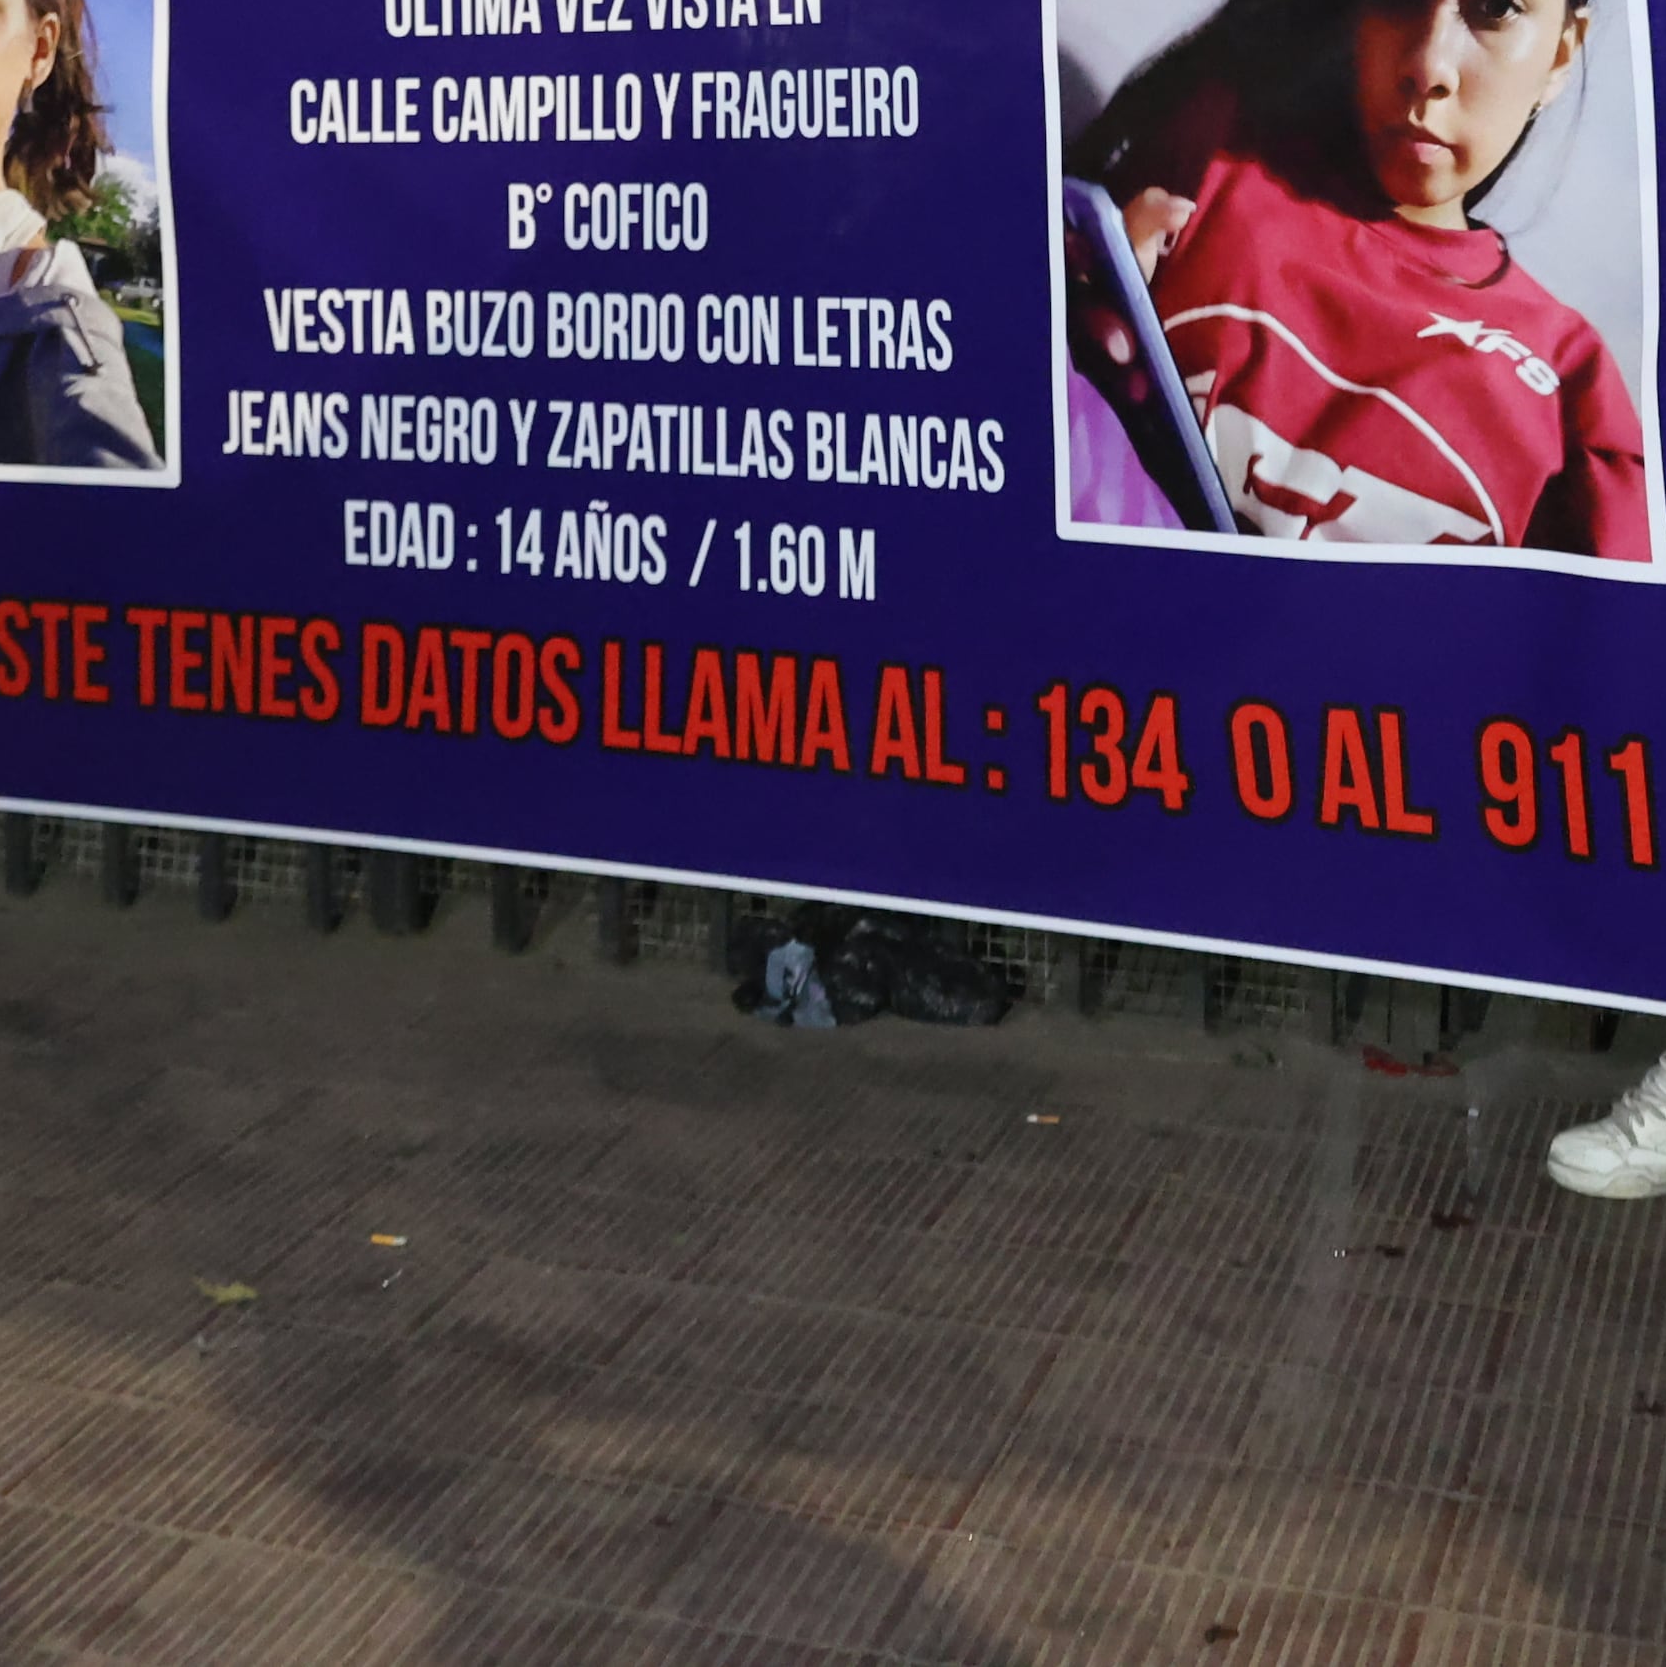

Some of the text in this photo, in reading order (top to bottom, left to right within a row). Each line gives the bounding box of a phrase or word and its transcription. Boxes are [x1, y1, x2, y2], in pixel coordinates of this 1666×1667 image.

[290, 65, 919, 145] CALLE CAMPILLO Y FRAGUEIRO
[564, 182, 708, 252] COFICO
[263, 287, 953, 372] VESTIA BUZO BORDO CON LETRAS
[222, 389, 1005, 493] JEANS NEGRO Y ZAPATILLAS BLANCAS
[344, 499, 455, 570] EDAD
[495, 507, 545, 576] 14
[554, 500, 667, 585] AÑOS
[734, 521, 826, 597] 1.60
[838, 527, 876, 601] M
[127, 609, 339, 720] TENES
[362, 624, 580, 743] DATOS
[603, 642, 850, 770] LLAMA
[871, 667, 965, 784] AL
[1039, 685, 1189, 810] 134
[1321, 708, 1433, 834] AL
[1480, 721, 1653, 865] 911
